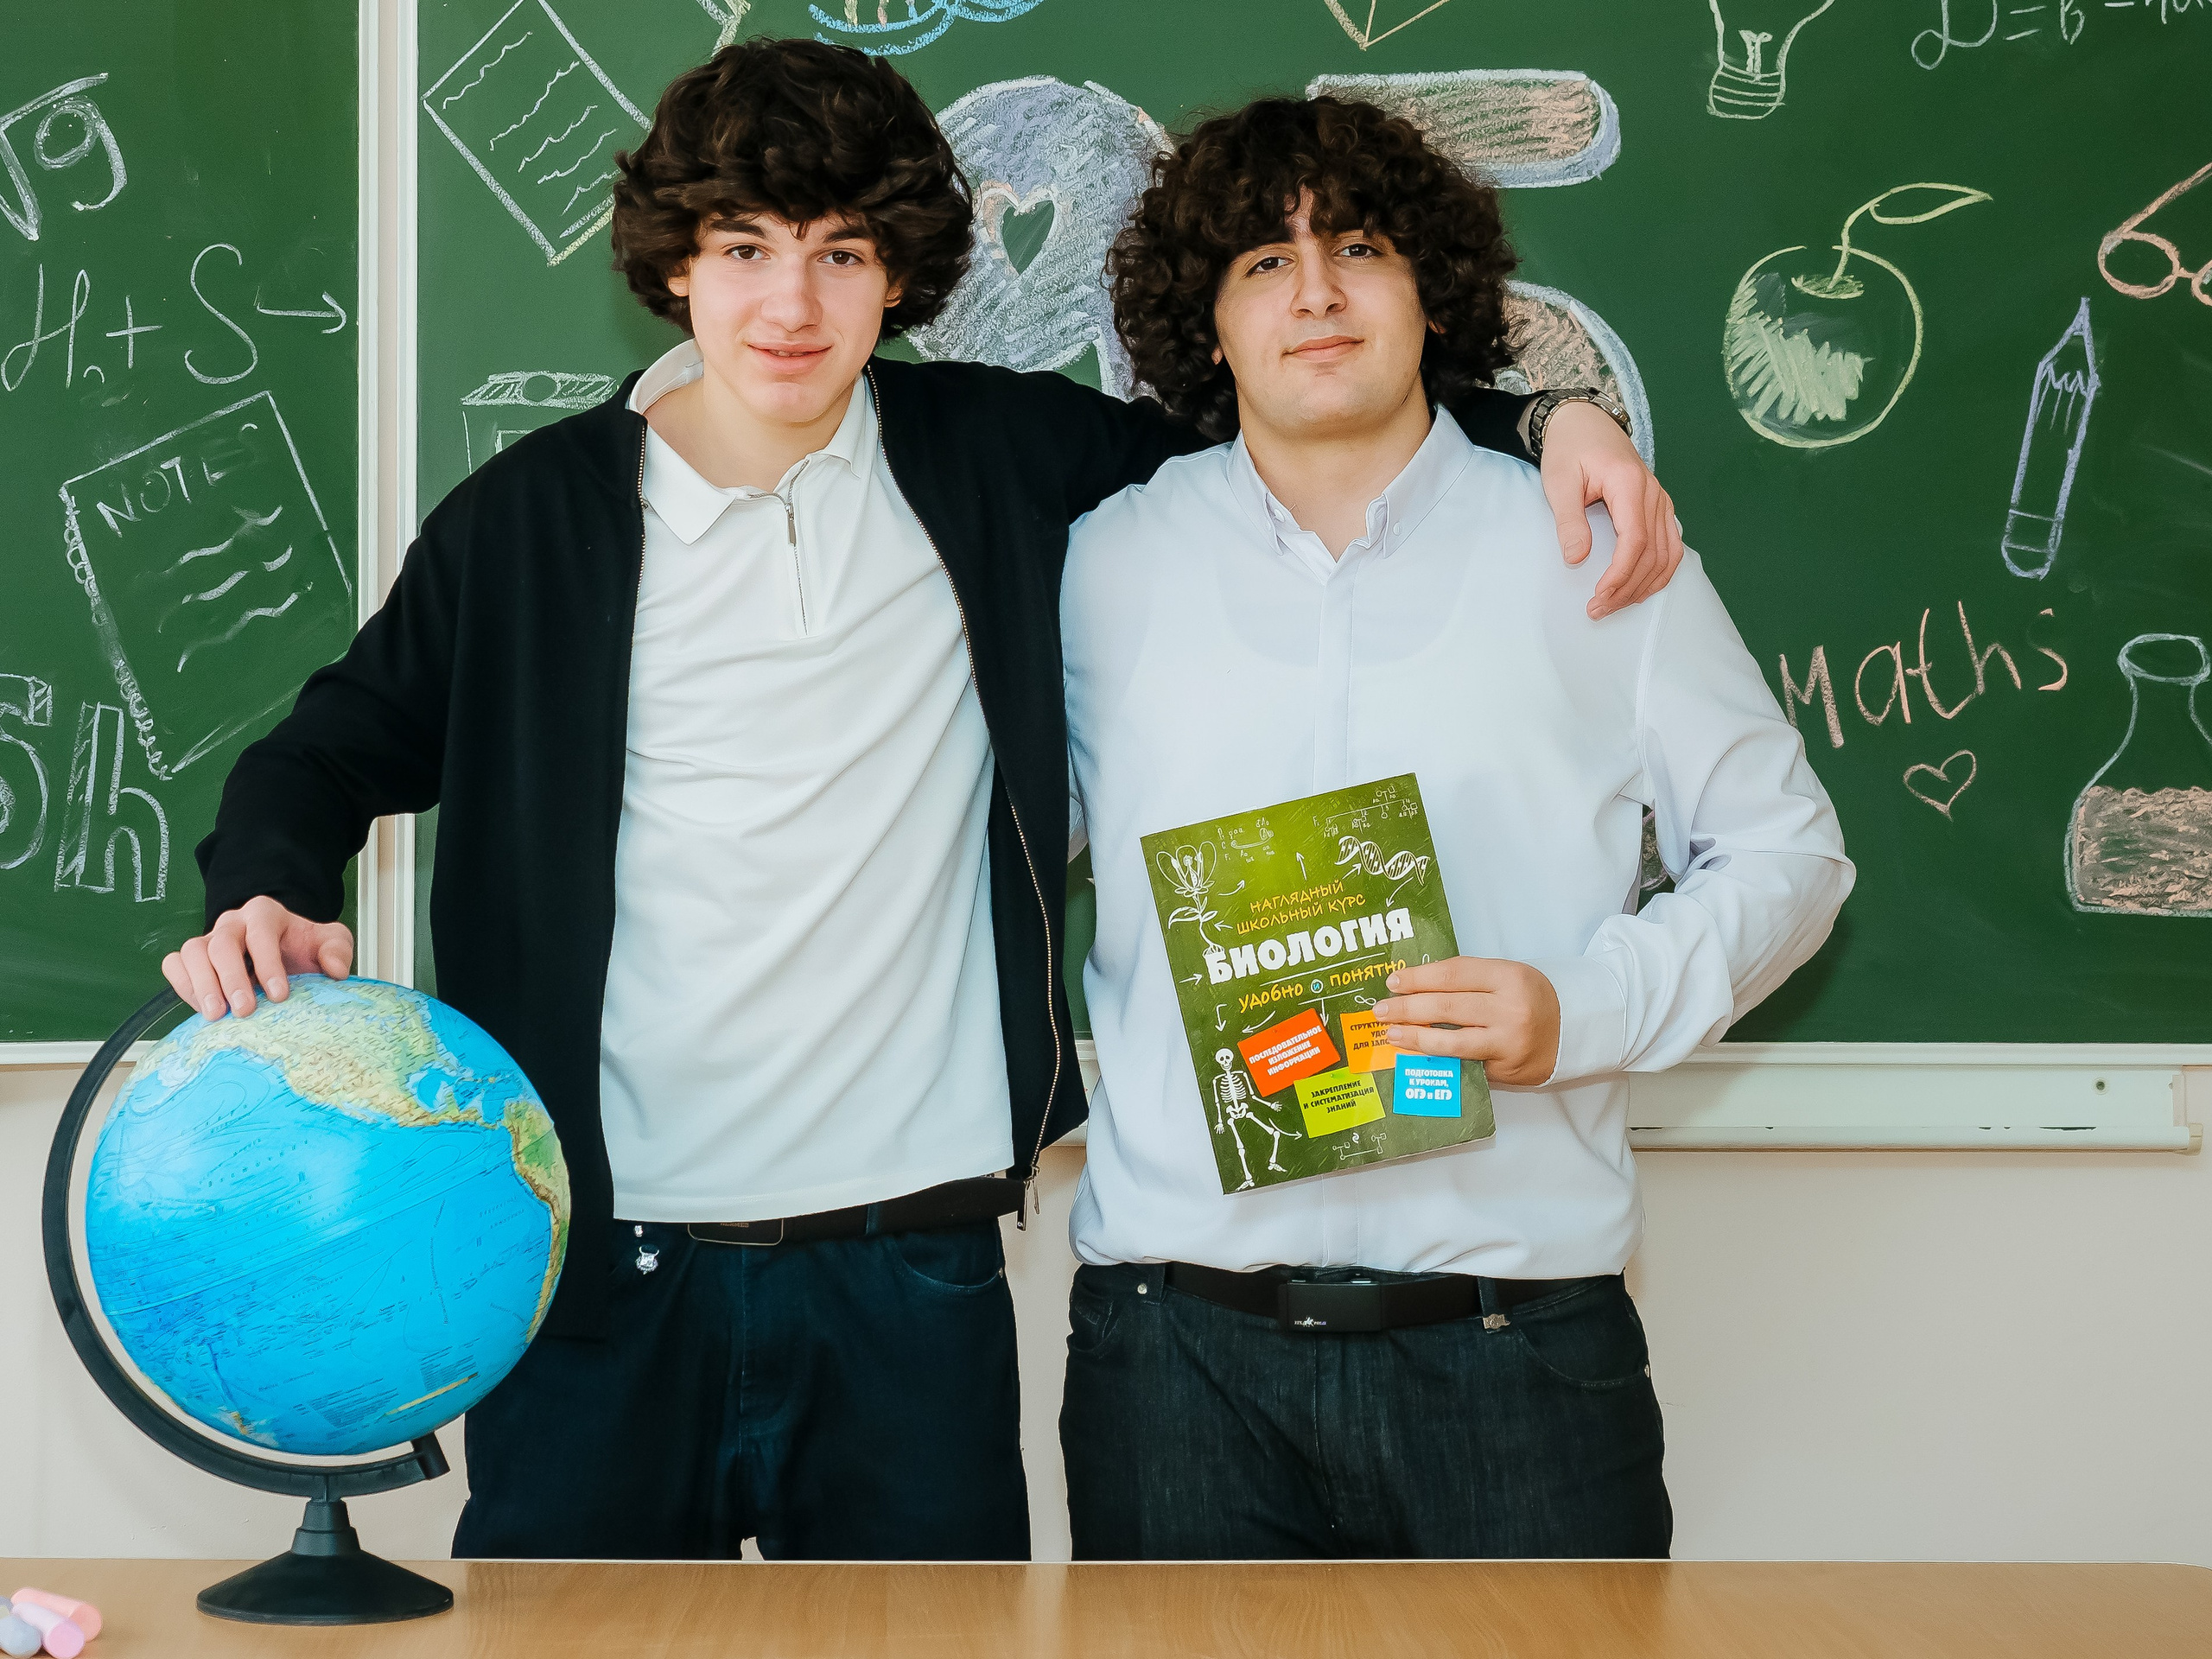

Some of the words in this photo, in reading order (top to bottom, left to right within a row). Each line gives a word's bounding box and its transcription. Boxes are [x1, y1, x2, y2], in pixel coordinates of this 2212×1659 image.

[1779, 600, 2068, 748] Maths
[1249, 880, 1344, 912] НАГЛЯДНЫЙ
[1236, 903, 1324, 935] ШКОЛЬНЫЙ
[1328, 893, 1366, 914] КУРС
[1205, 907, 1414, 985] БИОЛОГИЯ
[1249, 1025, 1323, 1065] ПОСЛЕДОВАТЕЛЬНОЕ
[1268, 1039, 1312, 1065] ИЗЛОЖЕНИЕ
[1353, 1041, 1370, 1051] ДЛЯ
[1267, 1046, 1321, 1076] ИНФОРМАЦИИ
[1404, 1068, 1453, 1078] ПОДГОТОВКА
[1310, 1086, 1375, 1109] СИСТЕМАТИЗАЦИЯ
[1311, 1079, 1362, 1098] ЗАКРЕПЛЕНИЕ
[1405, 1088, 1427, 1100] ОГЭ
[1434, 1089, 1452, 1101] ЕГЭ
[1326, 1098, 1356, 1114] ЗНАНИЙ
